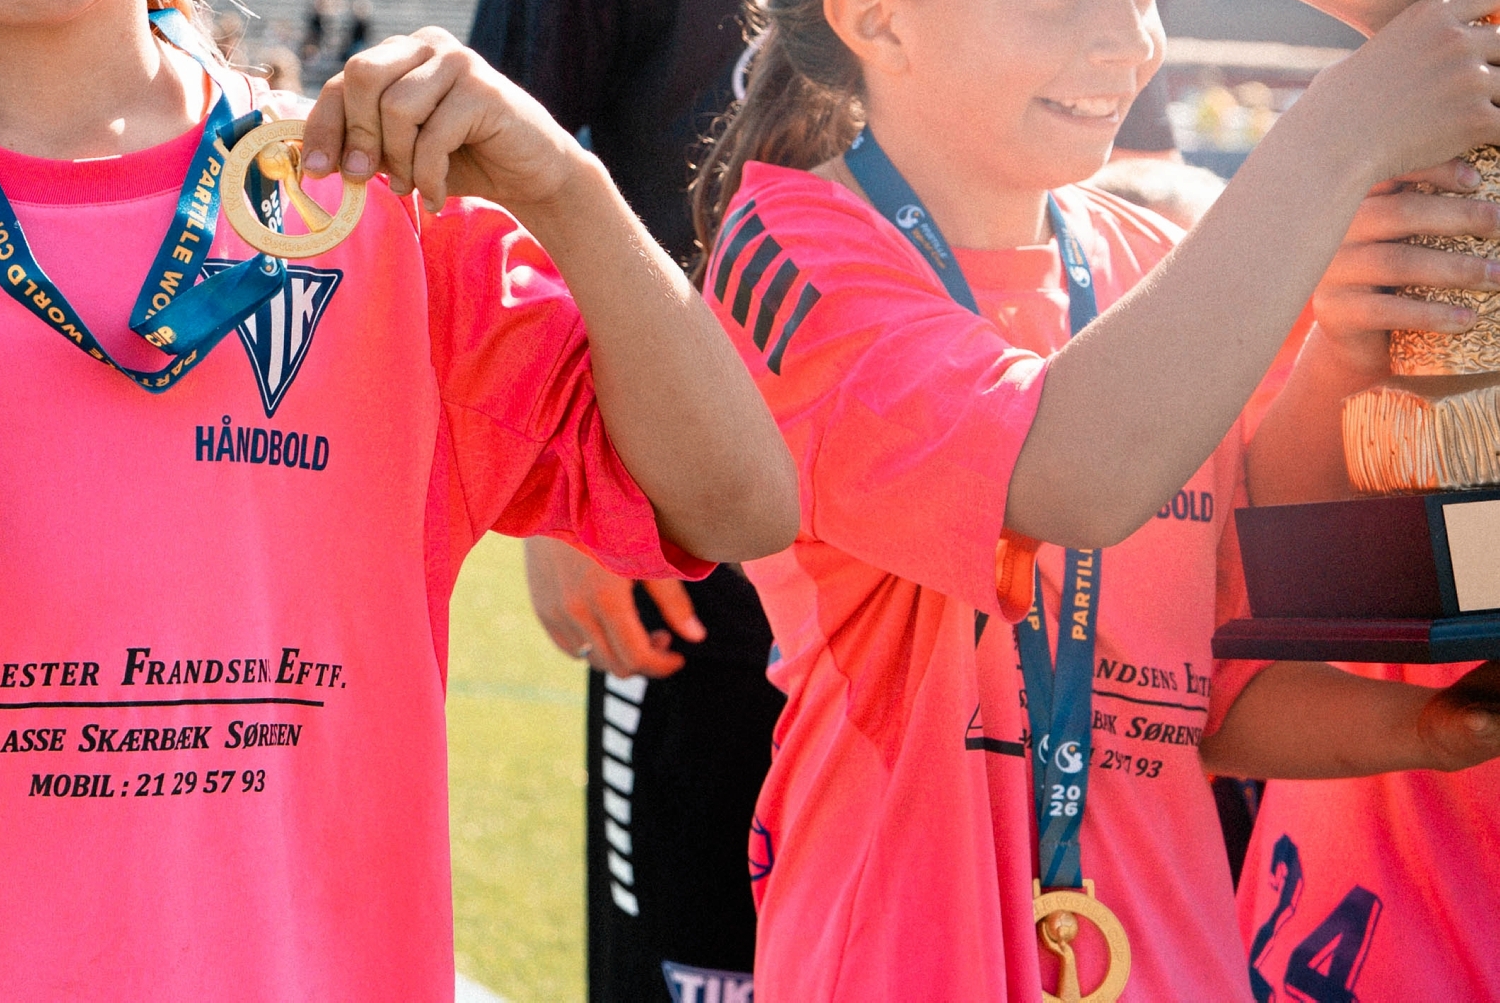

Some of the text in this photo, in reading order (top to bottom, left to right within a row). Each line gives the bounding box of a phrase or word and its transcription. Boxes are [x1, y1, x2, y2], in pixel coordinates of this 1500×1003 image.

[172, 156, 221, 265] PARTILLE
[7, 263, 84, 344] WORLD
[196, 414, 330, 472] HÅNDBOLD
[275, 648, 346, 689] EFTF.
[78, 724, 213, 753] SKÆRBÆK
[1135, 757, 1163, 778] 93
[29, 774, 115, 798] MOBIL
[135, 773, 165, 797] 21
[172, 771, 198, 796] 29
[203, 769, 237, 794] 57
[242, 769, 266, 793] 93
[1051, 784, 1081, 801] 20
[1049, 801, 1078, 817] 26
